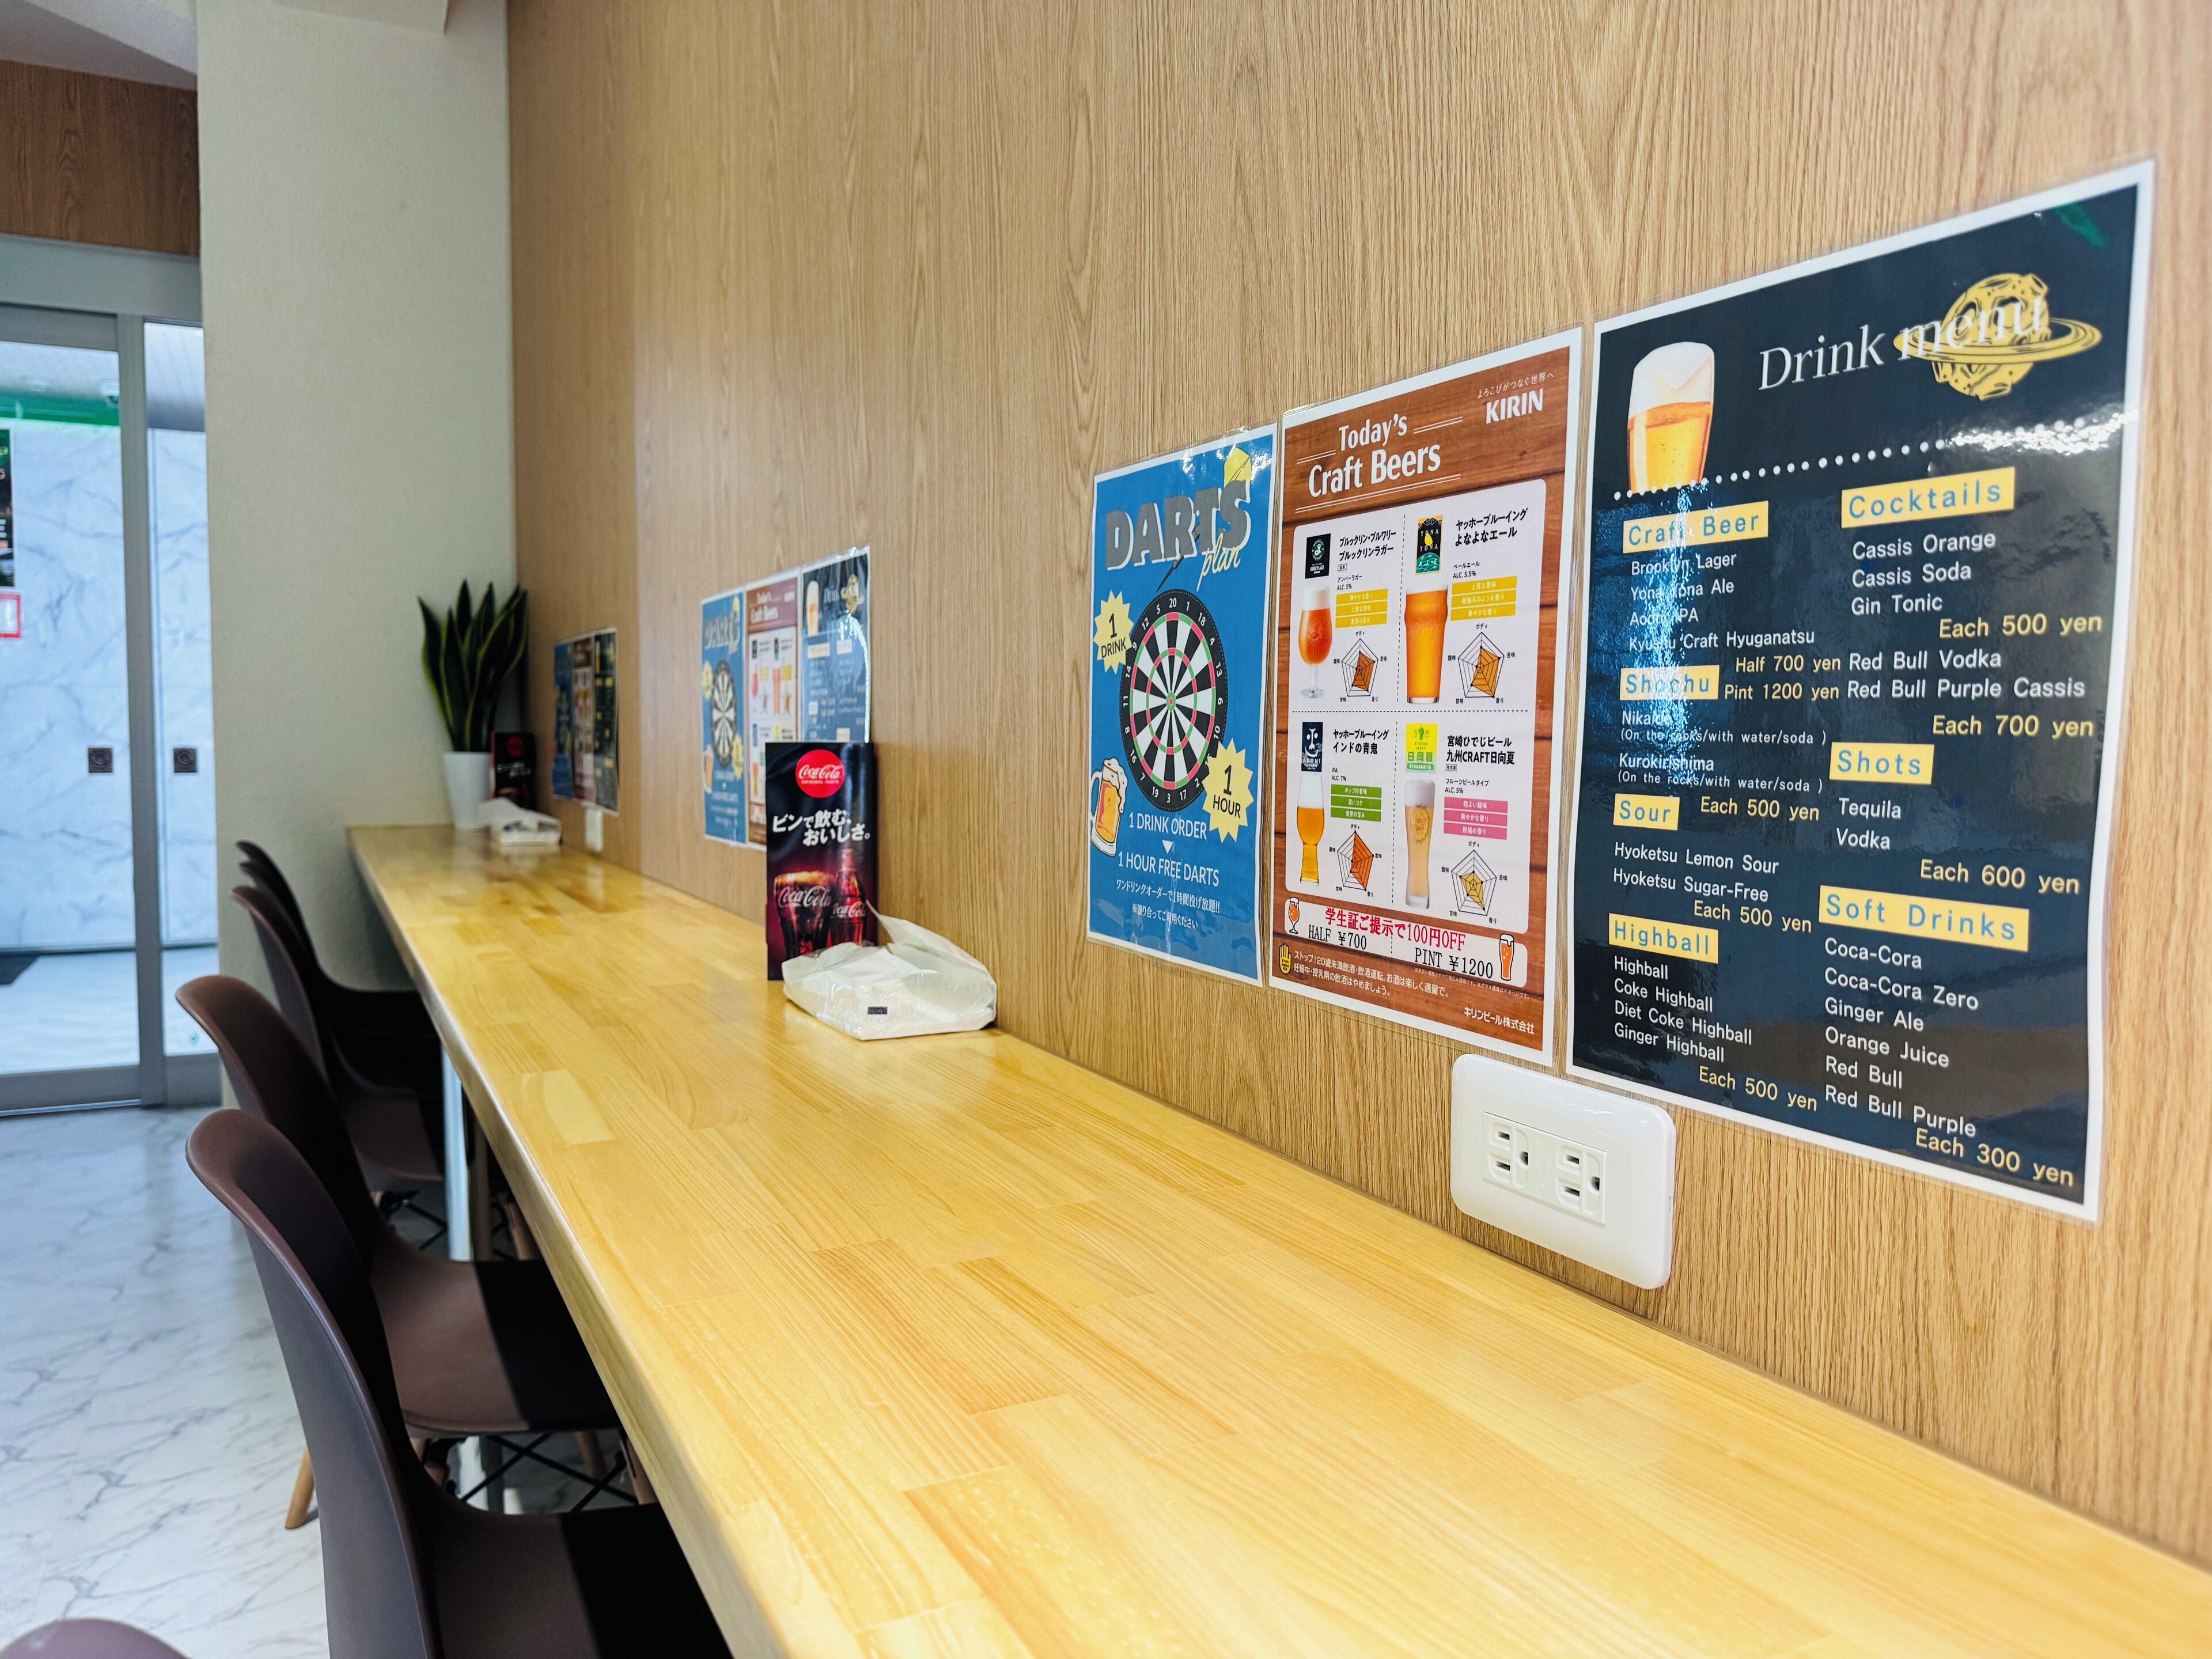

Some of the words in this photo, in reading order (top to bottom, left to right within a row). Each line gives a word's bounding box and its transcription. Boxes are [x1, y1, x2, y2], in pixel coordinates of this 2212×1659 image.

[1759, 324, 1886, 391] Drink
[1897, 296, 2041, 361] menu
[1477, 372, 1554, 399] よろこびがつなぐ世界へ
[1486, 388, 1544, 424] KIRIN
[1338, 413, 1407, 451] Today's
[1309, 456, 1363, 498] Craft
[1371, 444, 1441, 484] Beers
[1849, 480, 2001, 518] Cocktails
[1105, 480, 1251, 570] DARTS
[1456, 507, 1528, 531] ヤッホーブルーイング
[1703, 514, 1759, 536] Beer
[1455, 527, 1517, 547] よなよなエール
[1853, 538, 1912, 559] Cassis
[1923, 533, 1996, 553] Orange
[1197, 532, 1241, 592] plan
[1339, 544, 1394, 561] ブルックリンラガー
[1698, 553, 1737, 570] Lager
[1711, 578, 1734, 594] Ale
[1852, 567, 1911, 588] Cassis
[1922, 562, 1971, 582] Soda
[1169, 597, 1177, 608] 20
[1851, 597, 1881, 615] Gin
[1891, 593, 1943, 612] Tonic
[1108, 613, 1118, 639] 1
[1939, 617, 1989, 638] Each
[2002, 613, 2046, 634] 500
[2060, 615, 2102, 636] yen
[1101, 637, 1127, 658] DRINK
[1683, 632, 1718, 649] Craft
[1727, 630, 1815, 647] Hyuganatsu
[1736, 656, 1764, 673] Half
[1774, 655, 1804, 671] 700
[1813, 657, 1840, 673] yen
[1849, 652, 1883, 670] Red
[1893, 650, 1927, 669] Bull
[1939, 649, 2002, 668] Vodka
[1725, 684, 1753, 699] Pint
[1763, 683, 1802, 699] 1200
[1811, 685, 1839, 701] yen
[1847, 680, 1881, 699] Red
[1891, 679, 1926, 698] Bull
[1937, 678, 2002, 700] Purple
[2013, 676, 2085, 697] Cassis
[1333, 729, 1389, 740] ヤッホーブルーイング
[1933, 715, 1982, 735] Each
[1995, 715, 2039, 736] 700
[2051, 719, 2094, 738] yen
[1333, 741, 1378, 755] インドの青鬼
[1447, 735, 1512, 747] 宮崎ひでじビール
[1446, 749, 1515, 764] 九州CRAFT日向夏
[1619, 752, 1714, 771] Kurokirishima
[1837, 749, 1922, 776] Shots
[1223, 764, 1232, 796] 1
[1446, 778, 1489, 786] フルーツビールタイプ
[1643, 772, 1661, 784] the
[1738, 775, 1810, 791] water/soda
[772, 808, 852, 832] ビンで飲む、
[1213, 796, 1241, 819] HOUR
[1620, 800, 1671, 823] Sour
[1700, 796, 1738, 815] Each
[1747, 799, 1780, 818] 500
[1789, 805, 1820, 821] yen
[1839, 797, 1902, 820] Tequila
[802, 823, 870, 846] おいしさ。
[1129, 813, 1134, 829] 1
[1137, 815, 1169, 834] DRINK
[1171, 817, 1207, 839] ORDER
[1836, 828, 1891, 850] Vodka
[1119, 851, 1123, 867] 1
[1126, 854, 1156, 873] HOUR
[1158, 858, 1181, 878] FREE
[1184, 863, 1219, 887] DARTS
[1615, 842, 1677, 863] Hyoketsu
[1685, 849, 1733, 869] Lemon
[1742, 854, 1779, 874] Sour
[1613, 868, 1676, 890] Hyoketsu
[1684, 876, 1768, 902] Sugar-Free
[1920, 859, 1969, 882] Each
[1981, 864, 2025, 888] 600
[2038, 874, 2080, 894] yen
[1325, 907, 1466, 950] 学生証ご提示で100円OFF
[1694, 900, 1730, 921] Each
[1740, 907, 1772, 927] 500
[1782, 916, 1812, 933] yen
[1826, 893, 1886, 923] Soft
[1908, 903, 2015, 940] Drinks
[1308, 925, 1331, 942] HALF
[1338, 931, 1367, 950] ¥700
[1614, 920, 1709, 955] Highball
[1415, 947, 1442, 968] PINT
[1449, 955, 1493, 979] ¥1200
[1824, 937, 1922, 969] Coca-Cora
[1614, 955, 1668, 980] Highball
[1614, 978, 1647, 998] Coke
[1656, 986, 1713, 1013] Highball
[1824, 967, 1922, 1000] Coca-Cora
[1933, 985, 1979, 1010] Zero
[1464, 1006, 1535, 1035] キリンビール株式会社
[1615, 1000, 1642, 1020] Diet
[1648, 1008, 1684, 1029] Coke
[1692, 1017, 1752, 1045] Highball
[1825, 997, 1884, 1024] Ginger
[1893, 1010, 1924, 1032] Ale
[1614, 1022, 1658, 1046] Ginger
[1666, 1035, 1724, 1063] Highball
[1825, 1026, 1890, 1054] Orange
[1900, 1042, 1949, 1068] Juice
[1825, 1055, 1858, 1078] Red
[1869, 1065, 1902, 1089] Bull
[1699, 1066, 1736, 1089] Each
[1745, 1078, 1778, 1101] 500
[1787, 1092, 1817, 1111] yen
[1825, 1084, 1857, 1108] Red
[1868, 1094, 1902, 1119] Bull
[1913, 1105, 1976, 1138] Purple
[1915, 1127, 1964, 1157] Each
[1976, 1143, 2020, 1172] 300
[2032, 1162, 2073, 1187] yen
